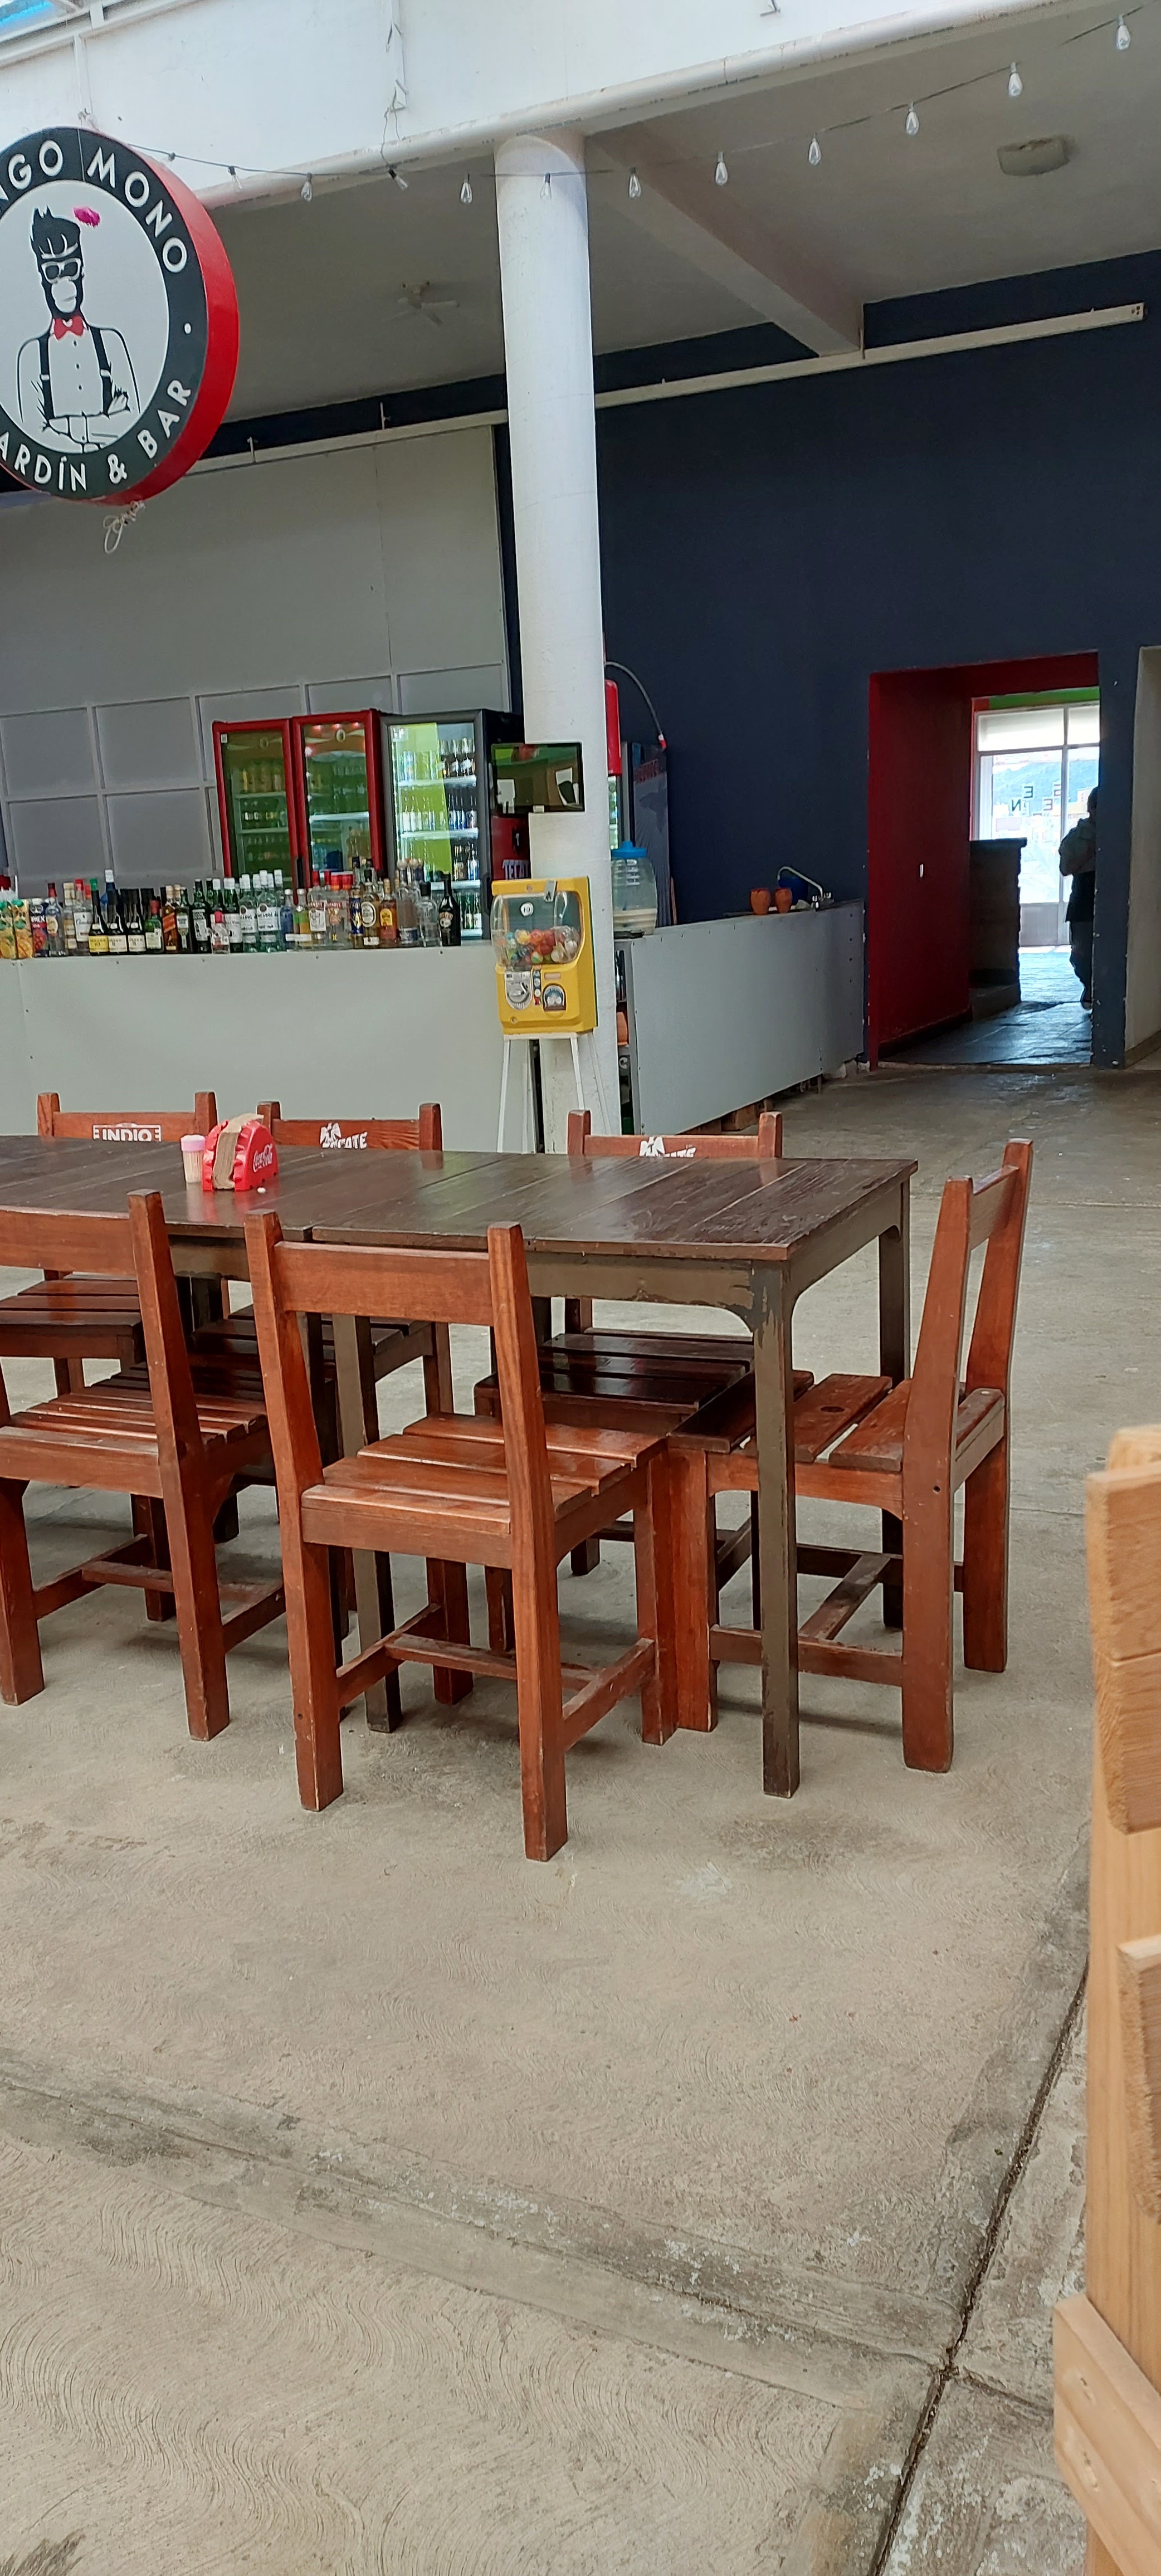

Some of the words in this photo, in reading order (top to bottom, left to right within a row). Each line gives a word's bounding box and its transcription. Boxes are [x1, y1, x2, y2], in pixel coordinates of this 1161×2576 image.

[87, 146, 188, 274] MONO
[108, 453, 128, 485] &
[137, 379, 191, 458] BAR
[102, 1129, 152, 1142] INDIO
